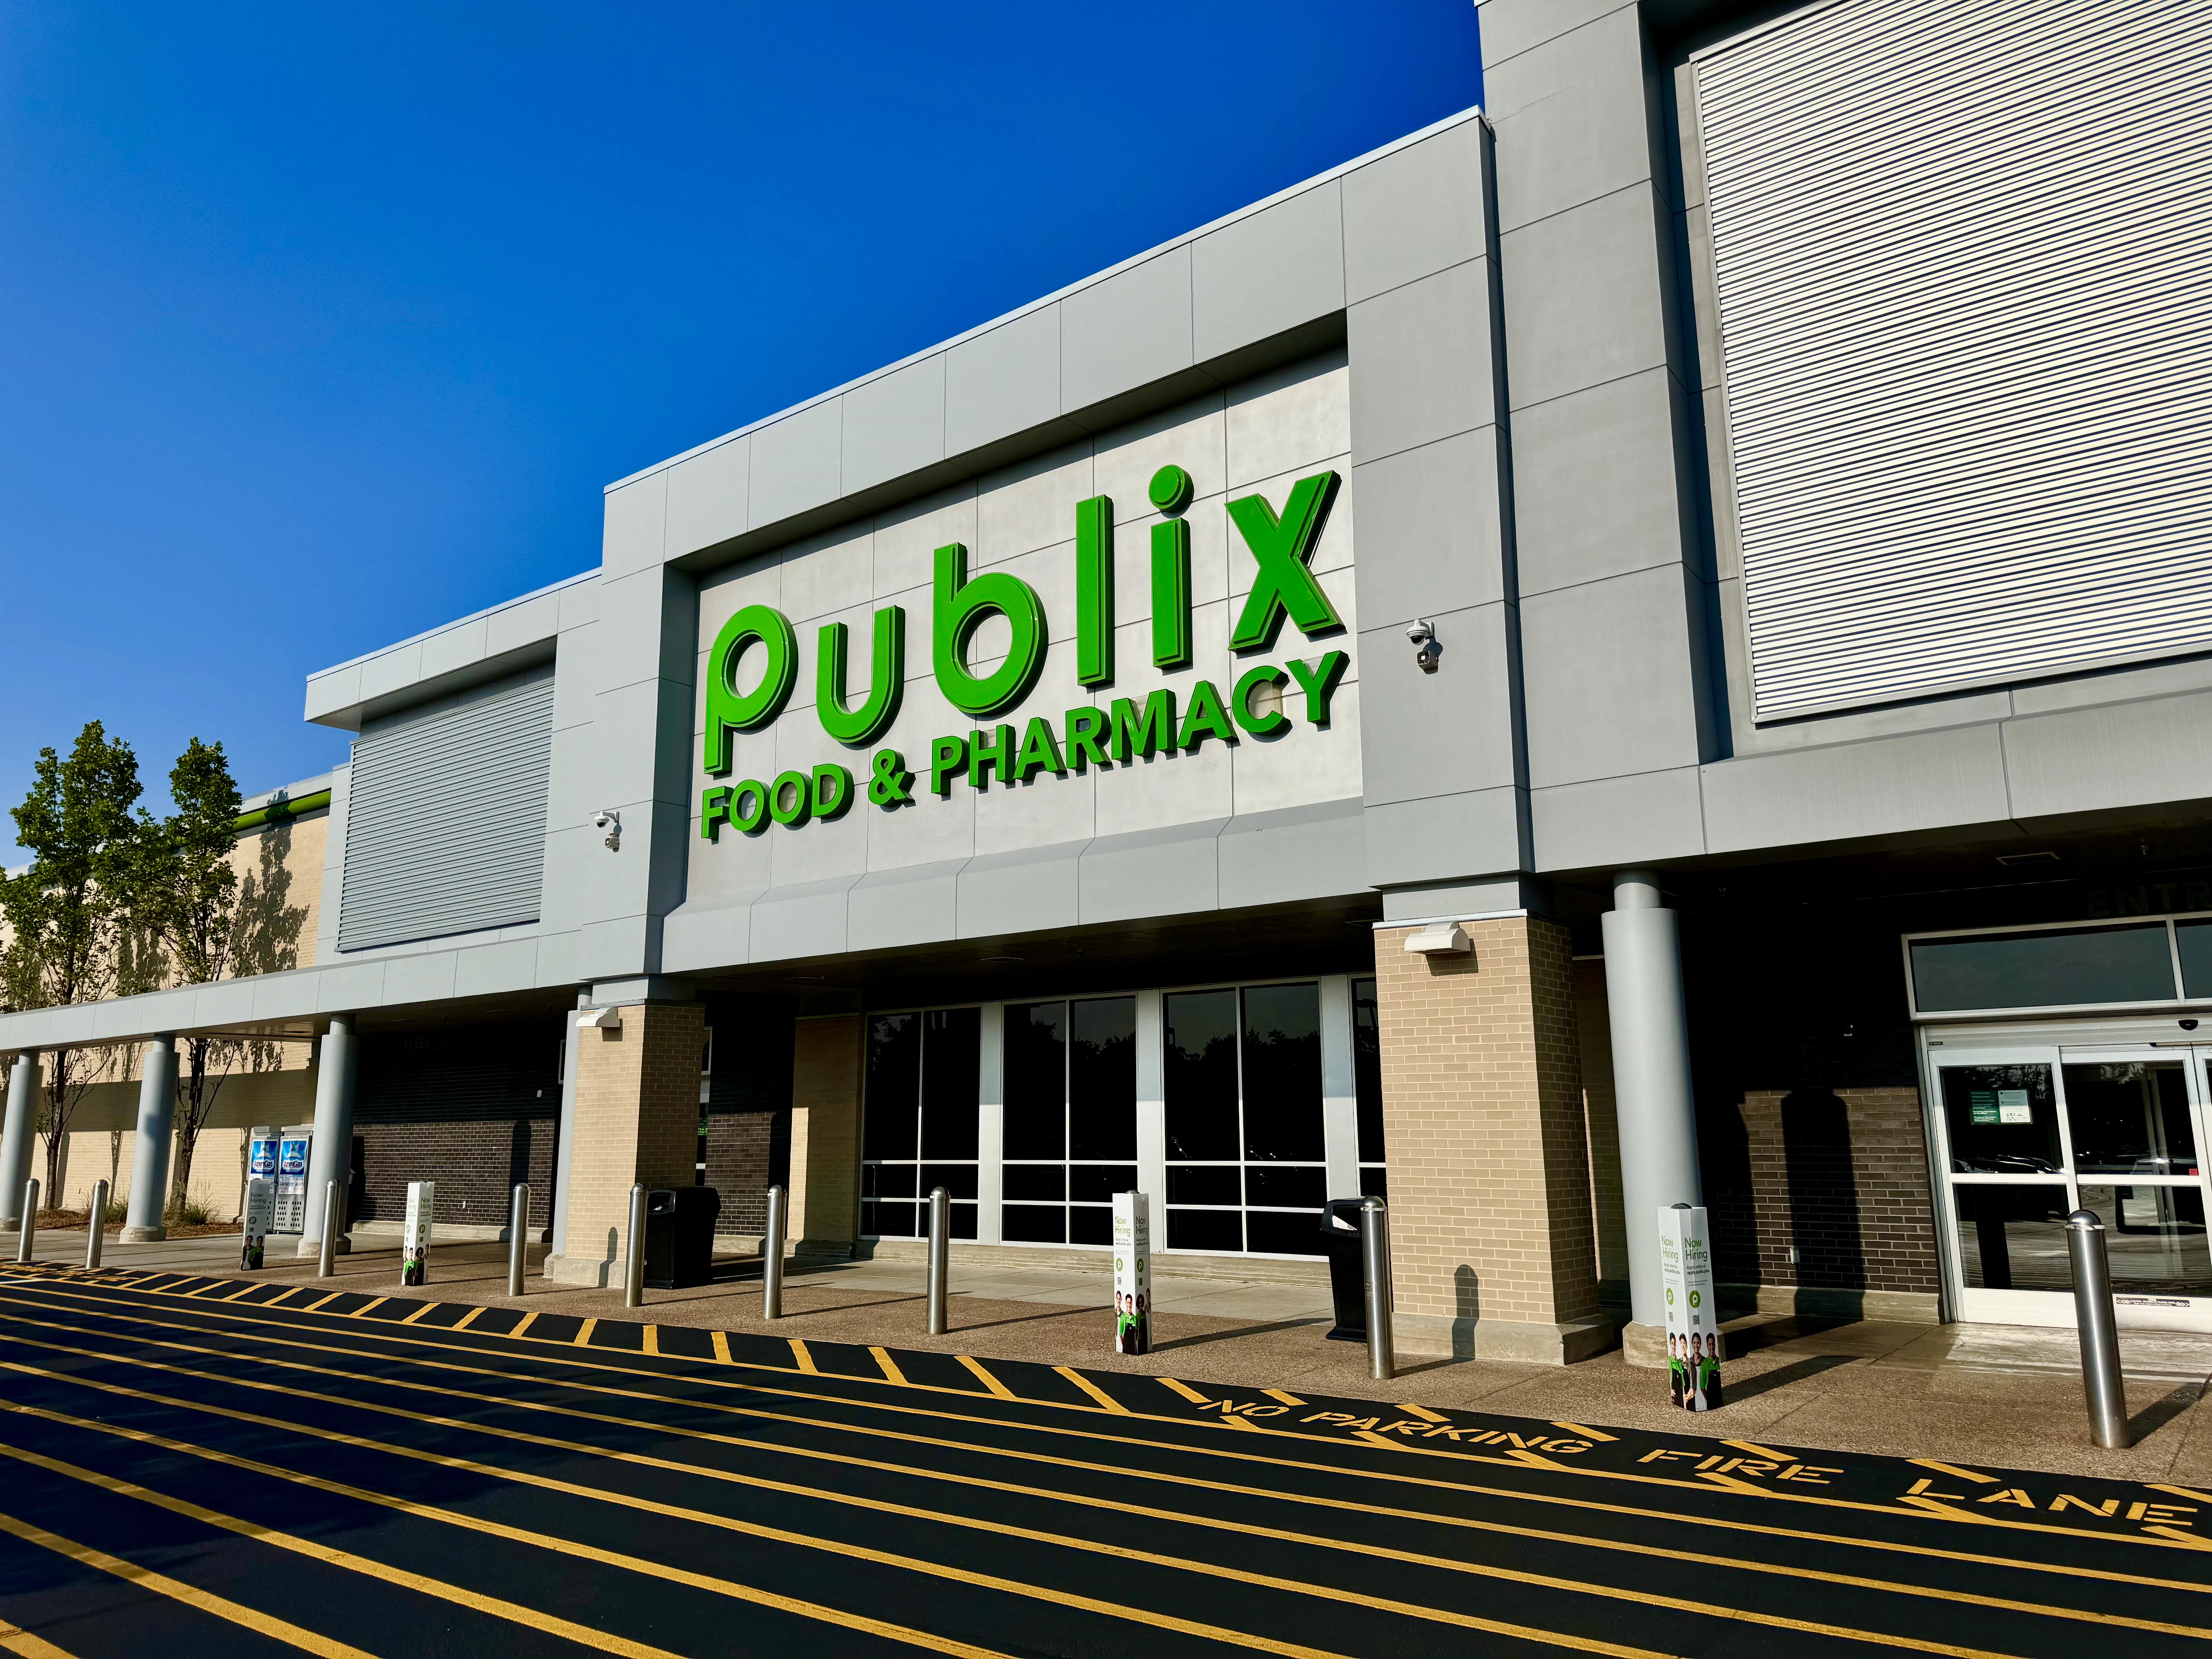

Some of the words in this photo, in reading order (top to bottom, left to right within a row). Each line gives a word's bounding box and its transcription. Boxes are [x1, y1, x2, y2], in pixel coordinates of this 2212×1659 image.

[701, 763, 854, 840] FOOD
[868, 749, 915, 807] &
[931, 650, 1349, 796] PHARMACY
[1115, 1216, 1126, 1224] Now
[1136, 1216, 1146, 1224] Now
[1115, 1225, 1130, 1237] Hiring
[1136, 1225, 1148, 1235] Hiring
[1661, 1235, 1673, 1247] Now
[1685, 1237, 1702, 1248] Now
[1662, 1247, 1678, 1262] Hiring
[1685, 1249, 1707, 1262] Hiring
[1197, 1400, 1290, 1417] NO
[1300, 1412, 1594, 1454] PARKING
[1637, 1449, 1844, 1485] FIRE
[1907, 1478, 2198, 1526] LANE
